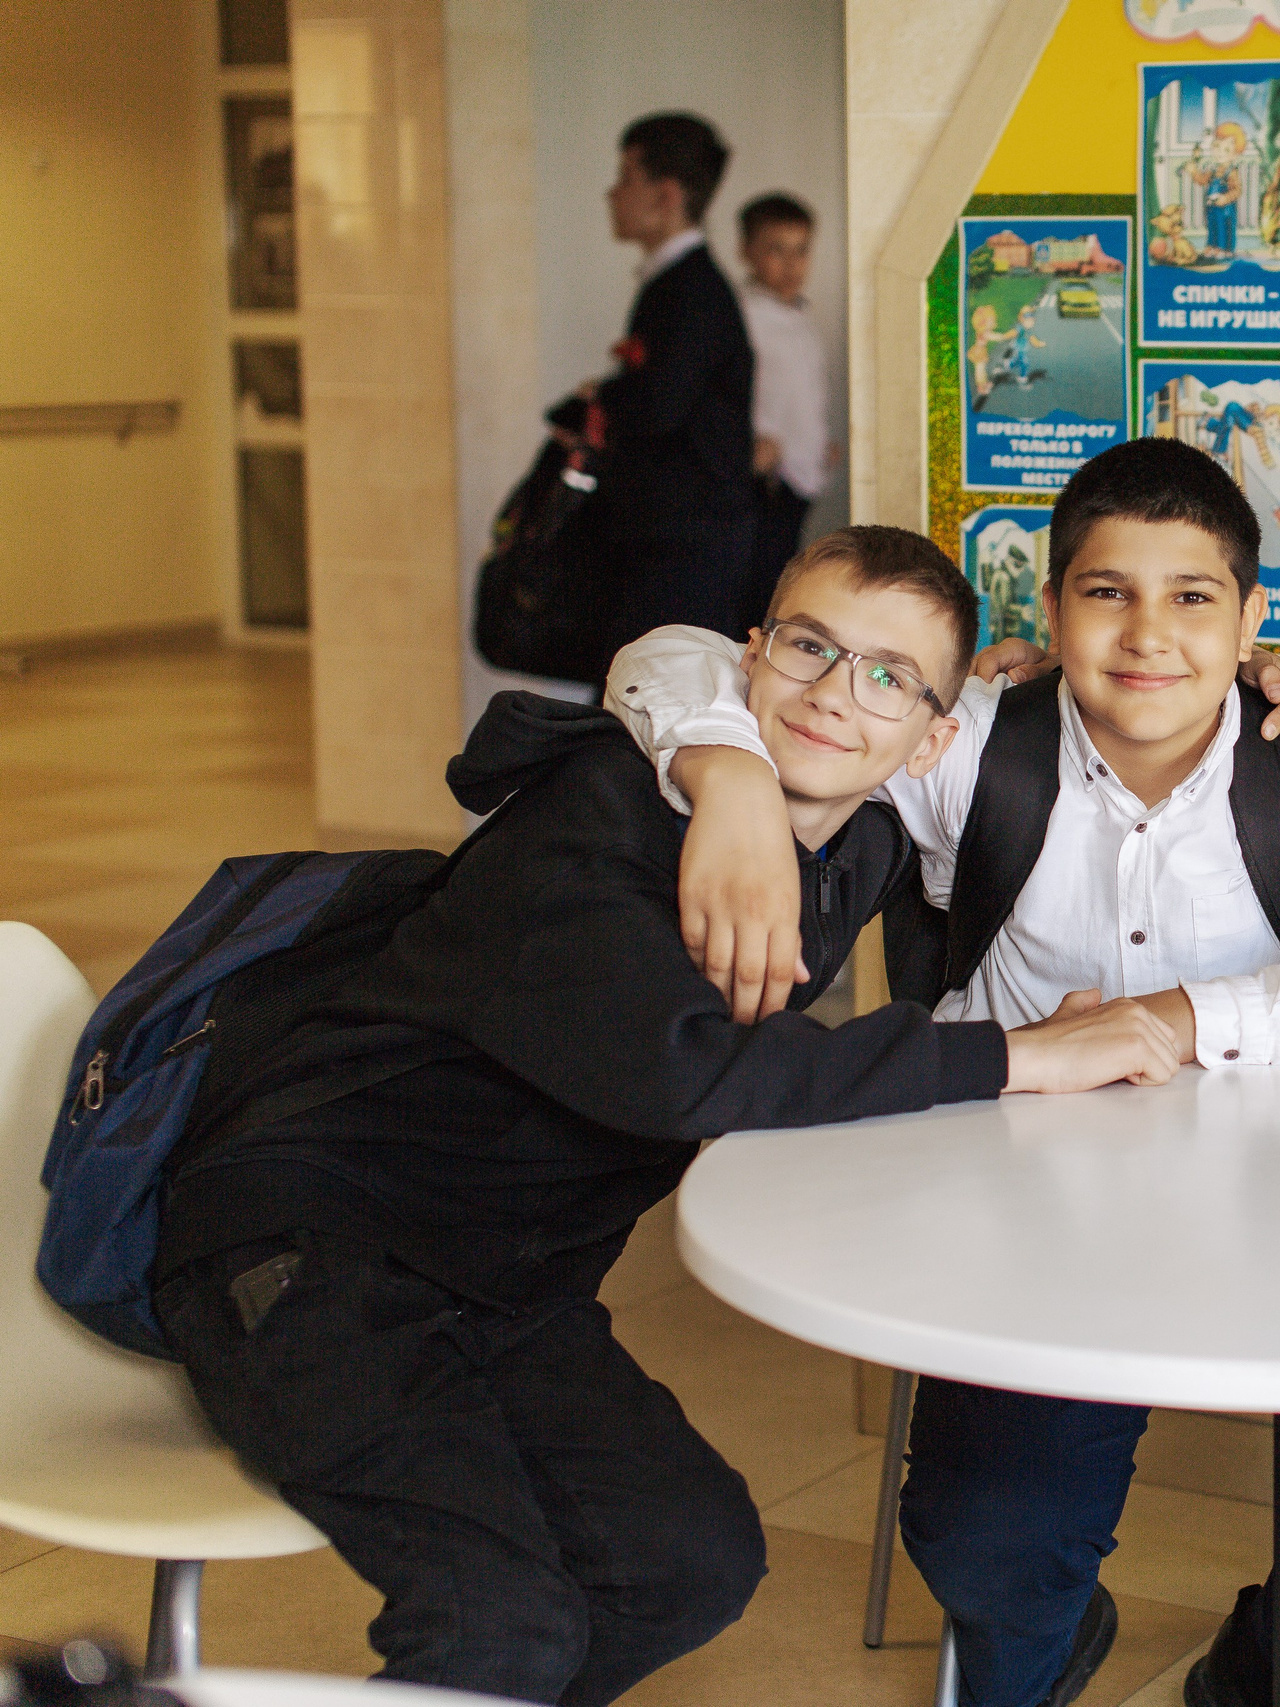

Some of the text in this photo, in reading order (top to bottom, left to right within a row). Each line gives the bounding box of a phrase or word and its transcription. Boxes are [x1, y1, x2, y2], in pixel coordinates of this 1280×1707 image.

[1172, 285, 1266, 304] СПИЧКИ
[1157, 309, 1187, 328] НЕ
[976, 421, 1117, 438] ПЕРЕХОДИ ДОРОГУ
[1009, 438, 1070, 454] ТОЛЬКО
